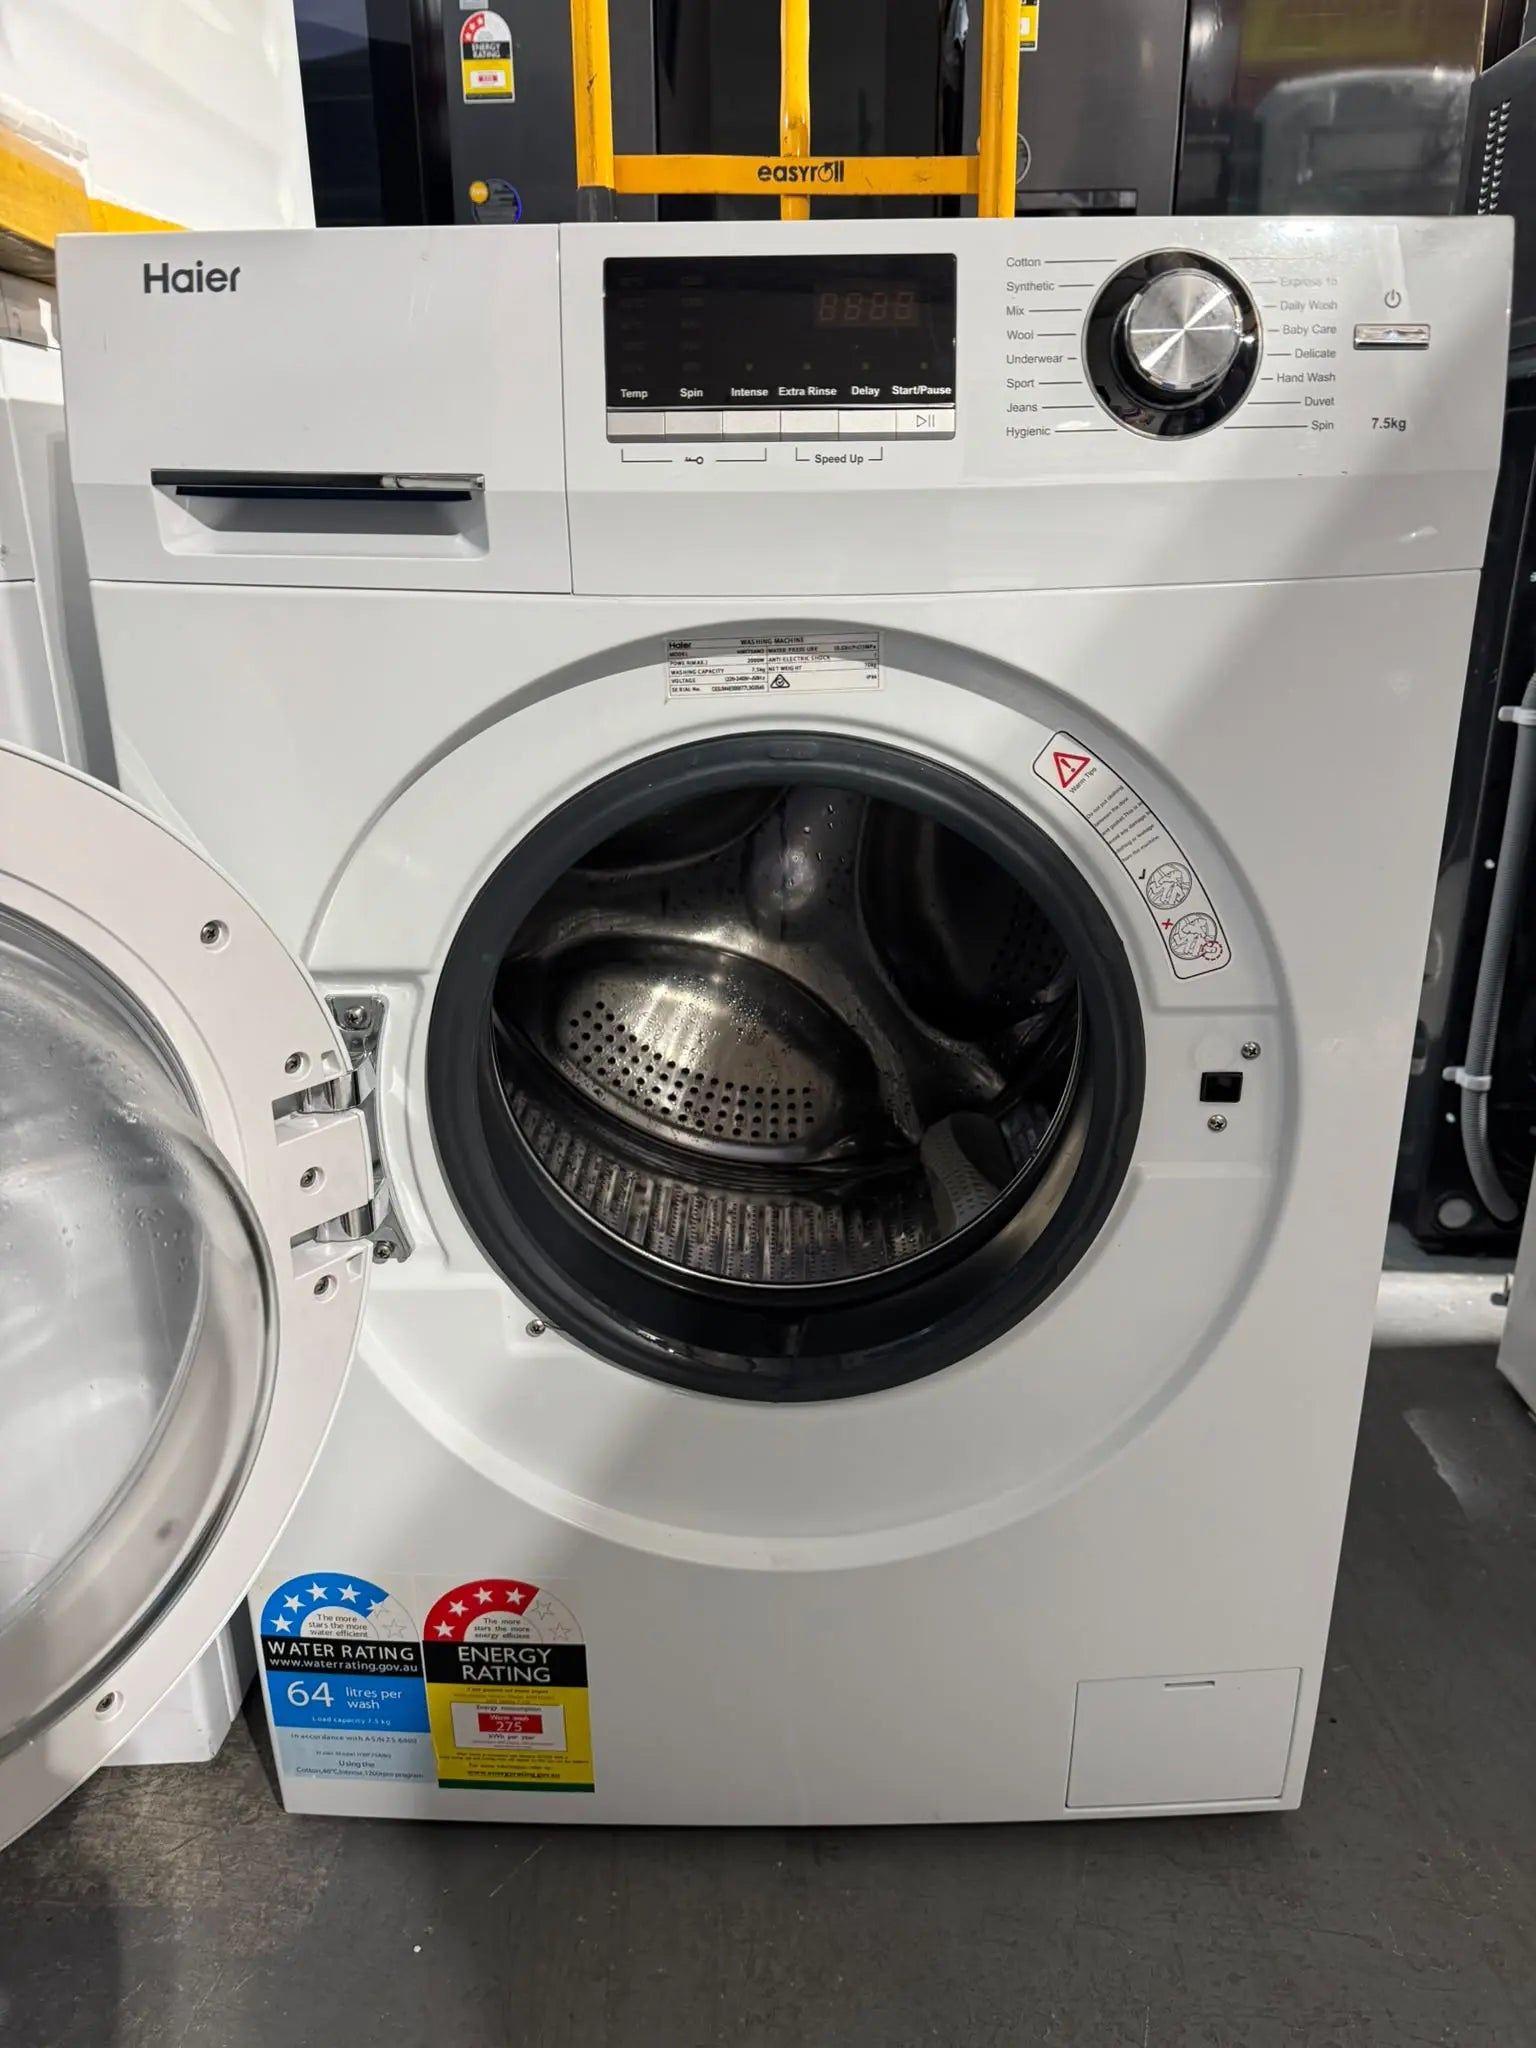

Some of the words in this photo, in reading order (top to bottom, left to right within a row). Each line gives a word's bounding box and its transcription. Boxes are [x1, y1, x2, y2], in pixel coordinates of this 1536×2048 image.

[758, 160, 844, 182] easyroll
[1006, 257, 1041, 267] Cotton
[144, 260, 240, 294] Haier
[1006, 281, 1055, 293] Synthetic
[1006, 306, 1024, 316] Mix
[1280, 301, 1306, 311] Daily
[1309, 301, 1338, 310] Wash
[1007, 330, 1034, 340] Wool
[1283, 325, 1308, 336] Baby
[1310, 325, 1337, 334] Care
[1007, 354, 1063, 364] Underwear
[1295, 349, 1336, 358] Delicate
[1277, 373, 1304, 382] Hand
[1308, 372, 1336, 382] Wash
[1007, 378, 1035, 389] Sport
[621, 389, 648, 400] Temp
[680, 388, 703, 399] Spin
[731, 388, 768, 397] Intense
[778, 387, 805, 396] Extra
[808, 386, 837, 396] Rinse
[851, 385, 880, 397] Delay
[892, 385, 952, 396] Start/Pause
[1305, 397, 1334, 406] Duvet
[1007, 403, 1038, 412] Jeans
[1312, 420, 1334, 431] Spin
[1371, 417, 1406, 431] 7.5kg
[1006, 427, 1051, 439] Hygienic
[815, 454, 846, 465] Speed
[849, 454, 864, 465] Up
[1069, 778, 1086, 794] Warm
[316, 1613, 333, 1621] The
[331, 1622, 344, 1630] the
[335, 1630, 368, 1638] efficient
[474, 1632, 500, 1640] energy
[268, 1641, 334, 1658] WATER
[342, 1645, 414, 1660] RATING
[458, 1646, 551, 1664] ENERGY
[269, 1658, 418, 1673] www.waterrating.gov.au
[463, 1665, 550, 1682] RATING
[287, 1680, 334, 1708] 64
[345, 1687, 377, 1699] litres
[381, 1690, 402, 1701] per
[347, 1700, 380, 1710] wash
[496, 1721, 522, 1732] 275
[339, 1760, 360, 1768] Using
